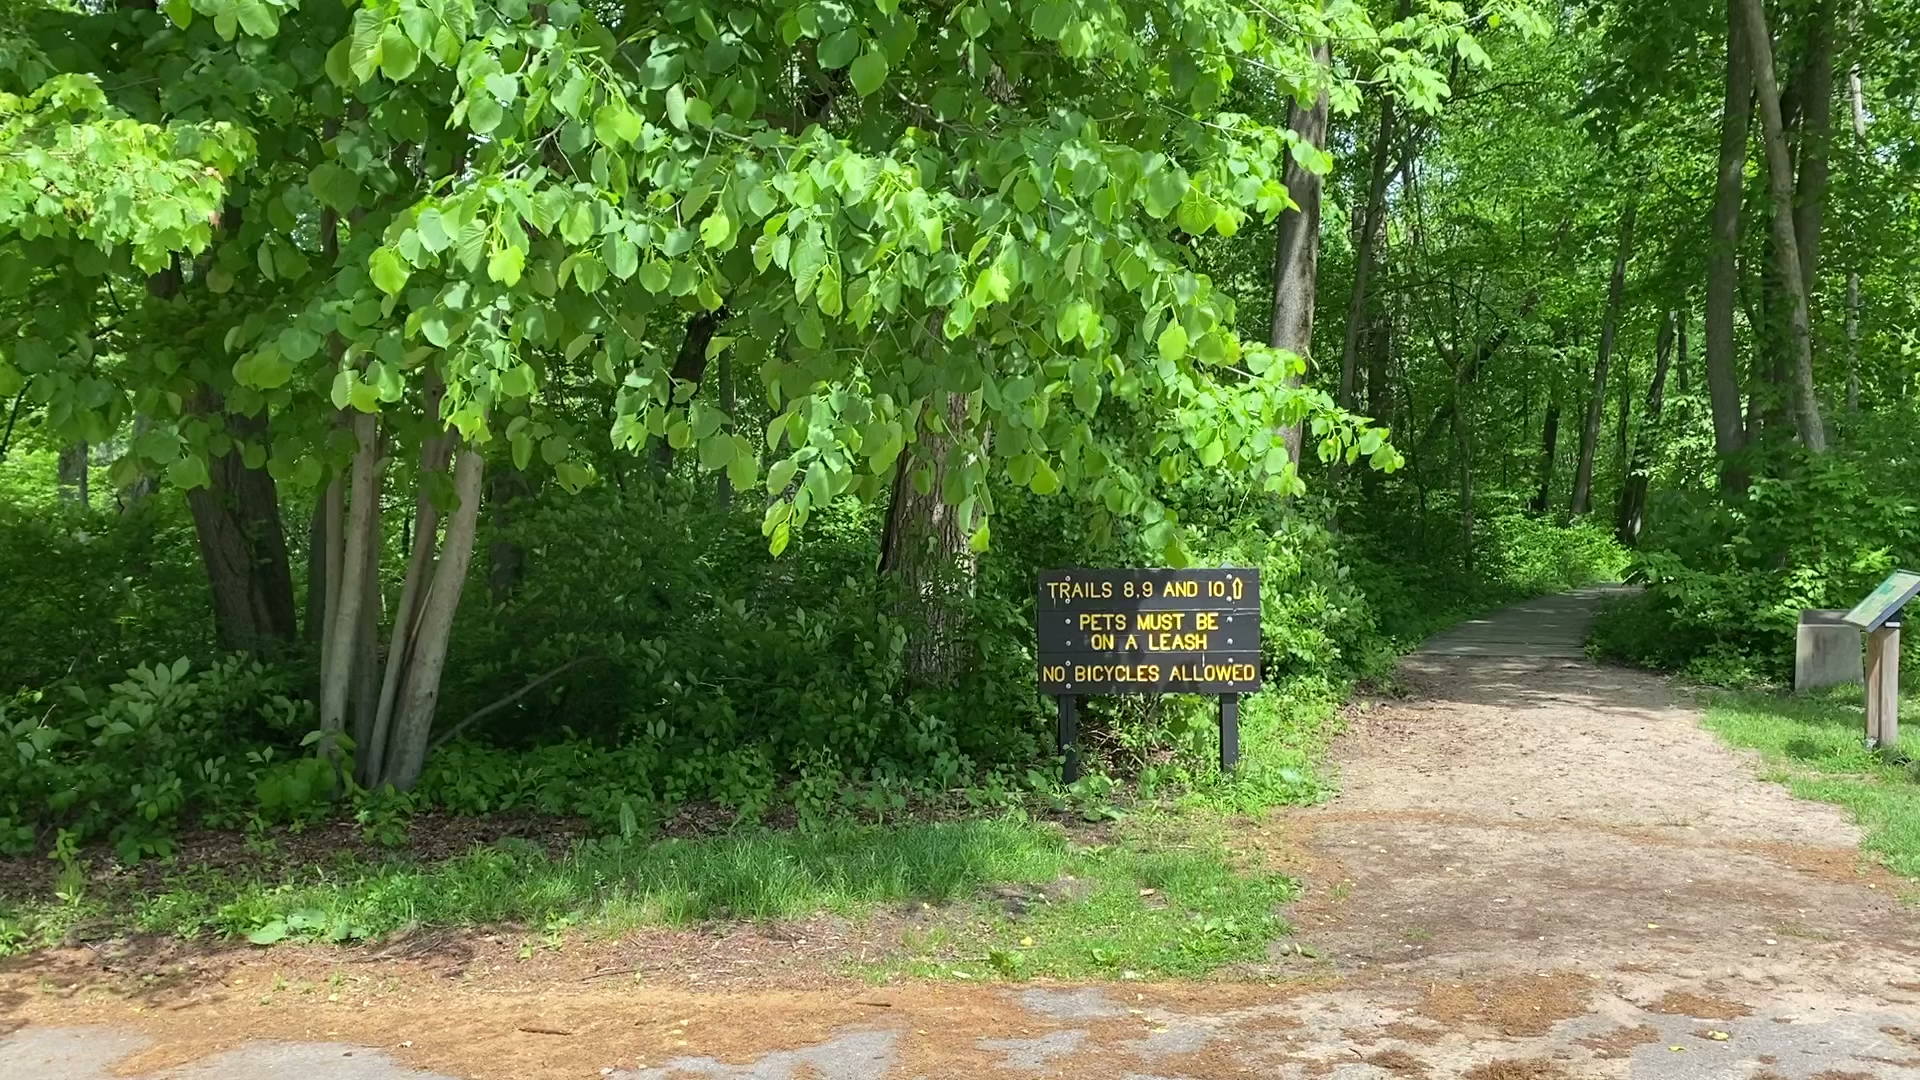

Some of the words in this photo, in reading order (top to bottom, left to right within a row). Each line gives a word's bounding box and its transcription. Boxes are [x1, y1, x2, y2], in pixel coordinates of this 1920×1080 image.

[1047, 582, 1112, 598] TRAILS
[1163, 582, 1197, 597] AND
[1080, 614, 1127, 631] PETS
[1137, 614, 1185, 630] MUST
[1196, 613, 1218, 630] BE
[1092, 634, 1114, 650] ON
[1125, 634, 1138, 650] A
[1149, 634, 1207, 650] LEASH
[1043, 666, 1065, 682] NO
[1075, 666, 1159, 682] BICYCLES
[1169, 665, 1255, 681] ALLOWED
